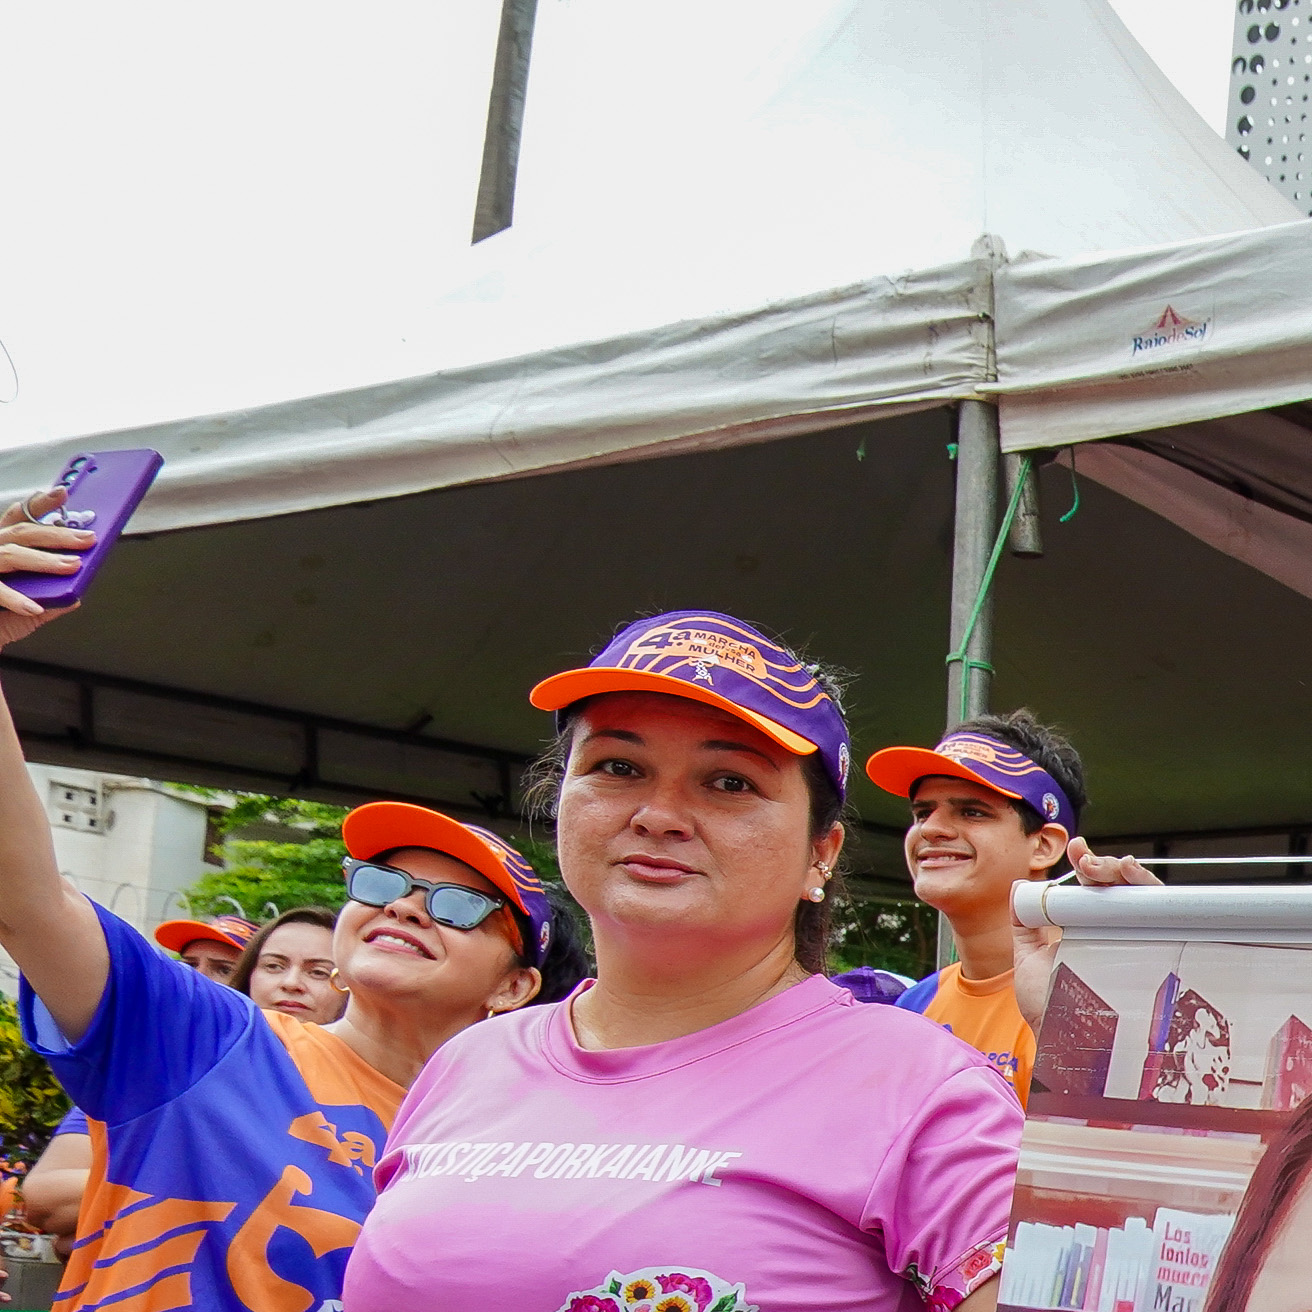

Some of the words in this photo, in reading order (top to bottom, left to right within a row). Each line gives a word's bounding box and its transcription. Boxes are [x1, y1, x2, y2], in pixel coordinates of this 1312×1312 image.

[688, 644, 756, 673] MULHER
[694, 632, 756, 660] MARCHA
[1165, 1221, 1191, 1244] Los
